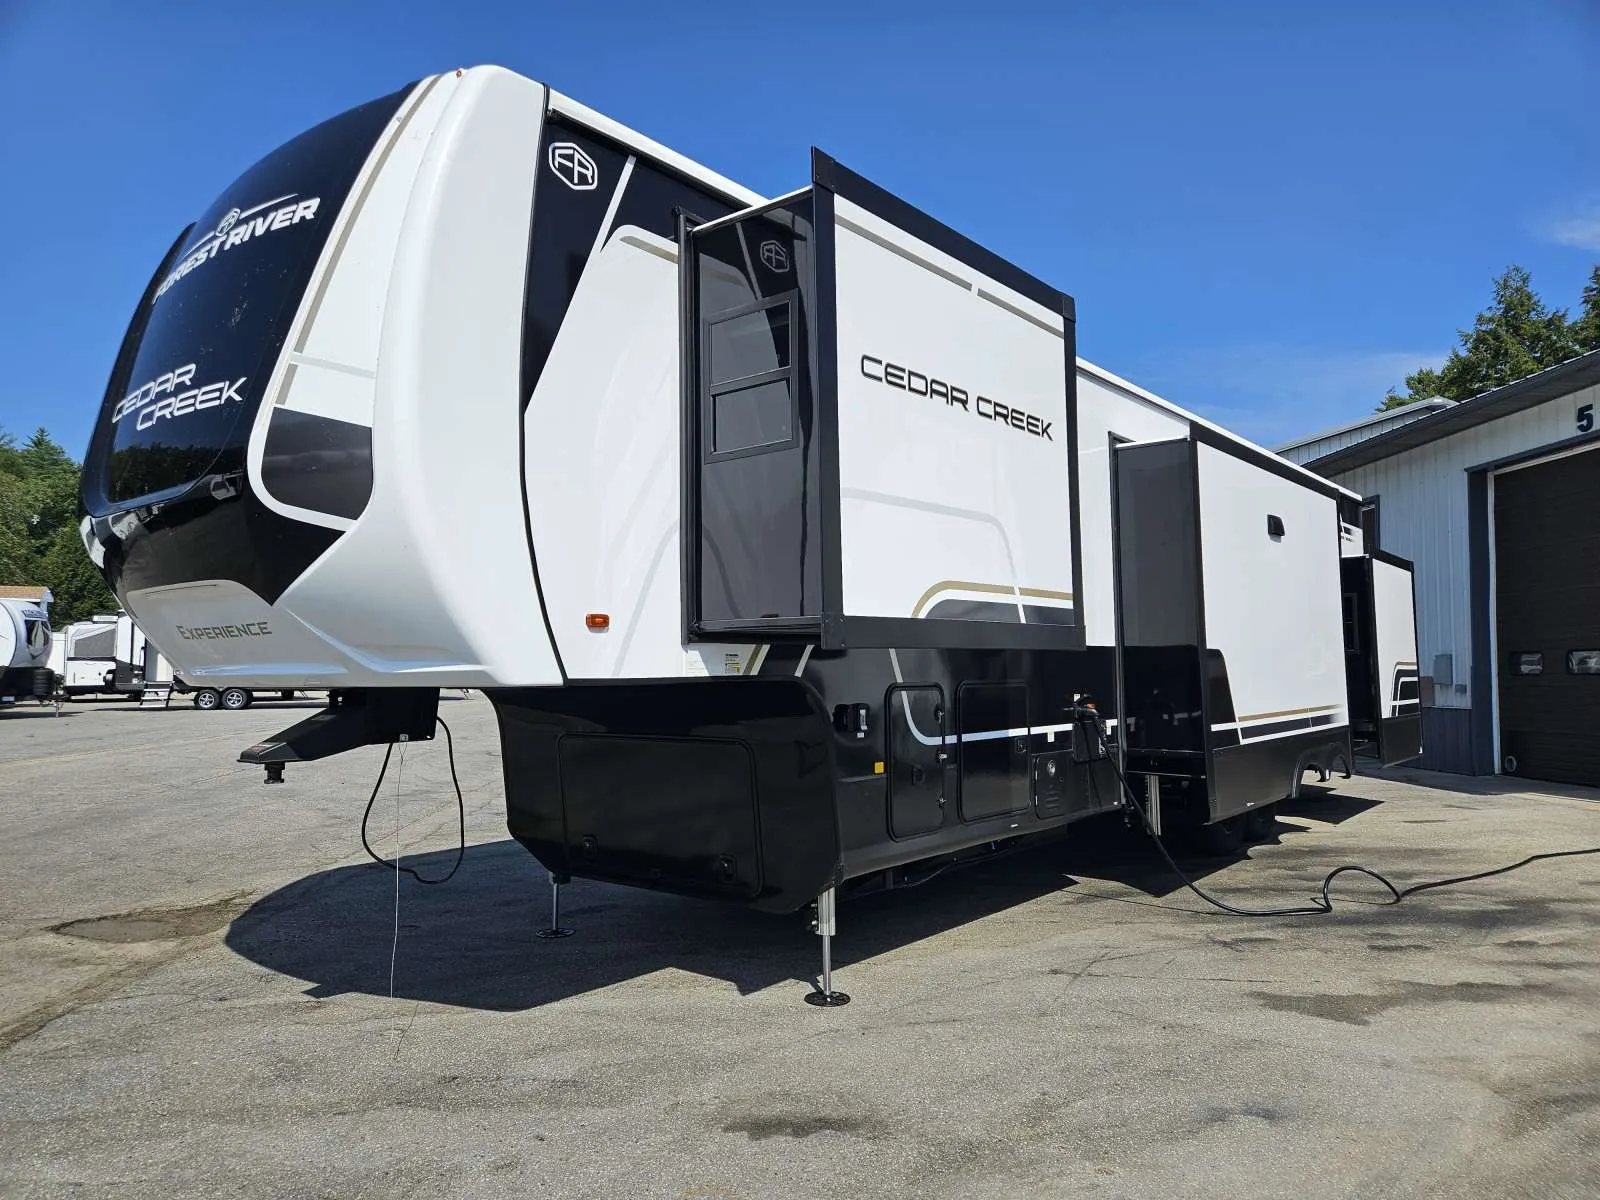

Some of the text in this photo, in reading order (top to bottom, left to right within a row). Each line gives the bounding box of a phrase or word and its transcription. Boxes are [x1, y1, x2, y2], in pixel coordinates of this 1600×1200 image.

[152, 235, 228, 305] FOREST
[223, 197, 321, 251] RIVER
[112, 363, 197, 424] CEDAR
[136, 377, 248, 431] CREEK
[860, 354, 1054, 442] CEDAR CREEK
[1576, 403, 1594, 433] 5
